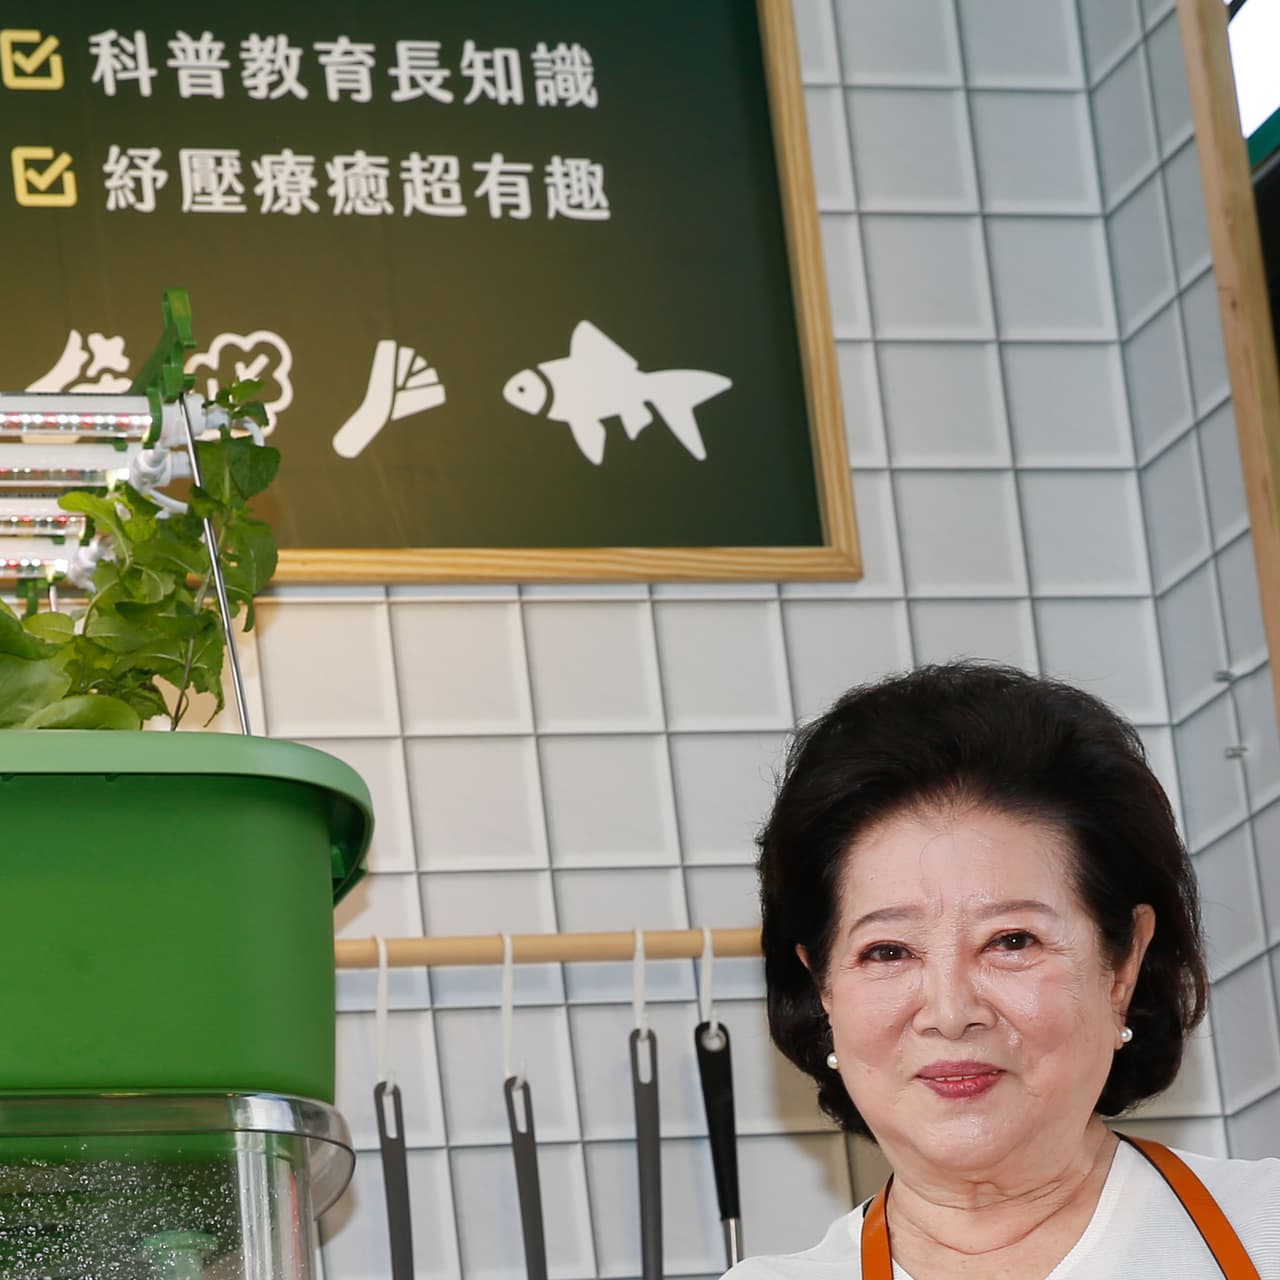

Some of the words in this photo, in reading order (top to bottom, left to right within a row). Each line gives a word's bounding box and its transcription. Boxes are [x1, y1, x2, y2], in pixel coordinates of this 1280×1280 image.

[89, 29, 599, 108] 科普教育長知識
[103, 145, 611, 221] 紓壓療癒超有趣
